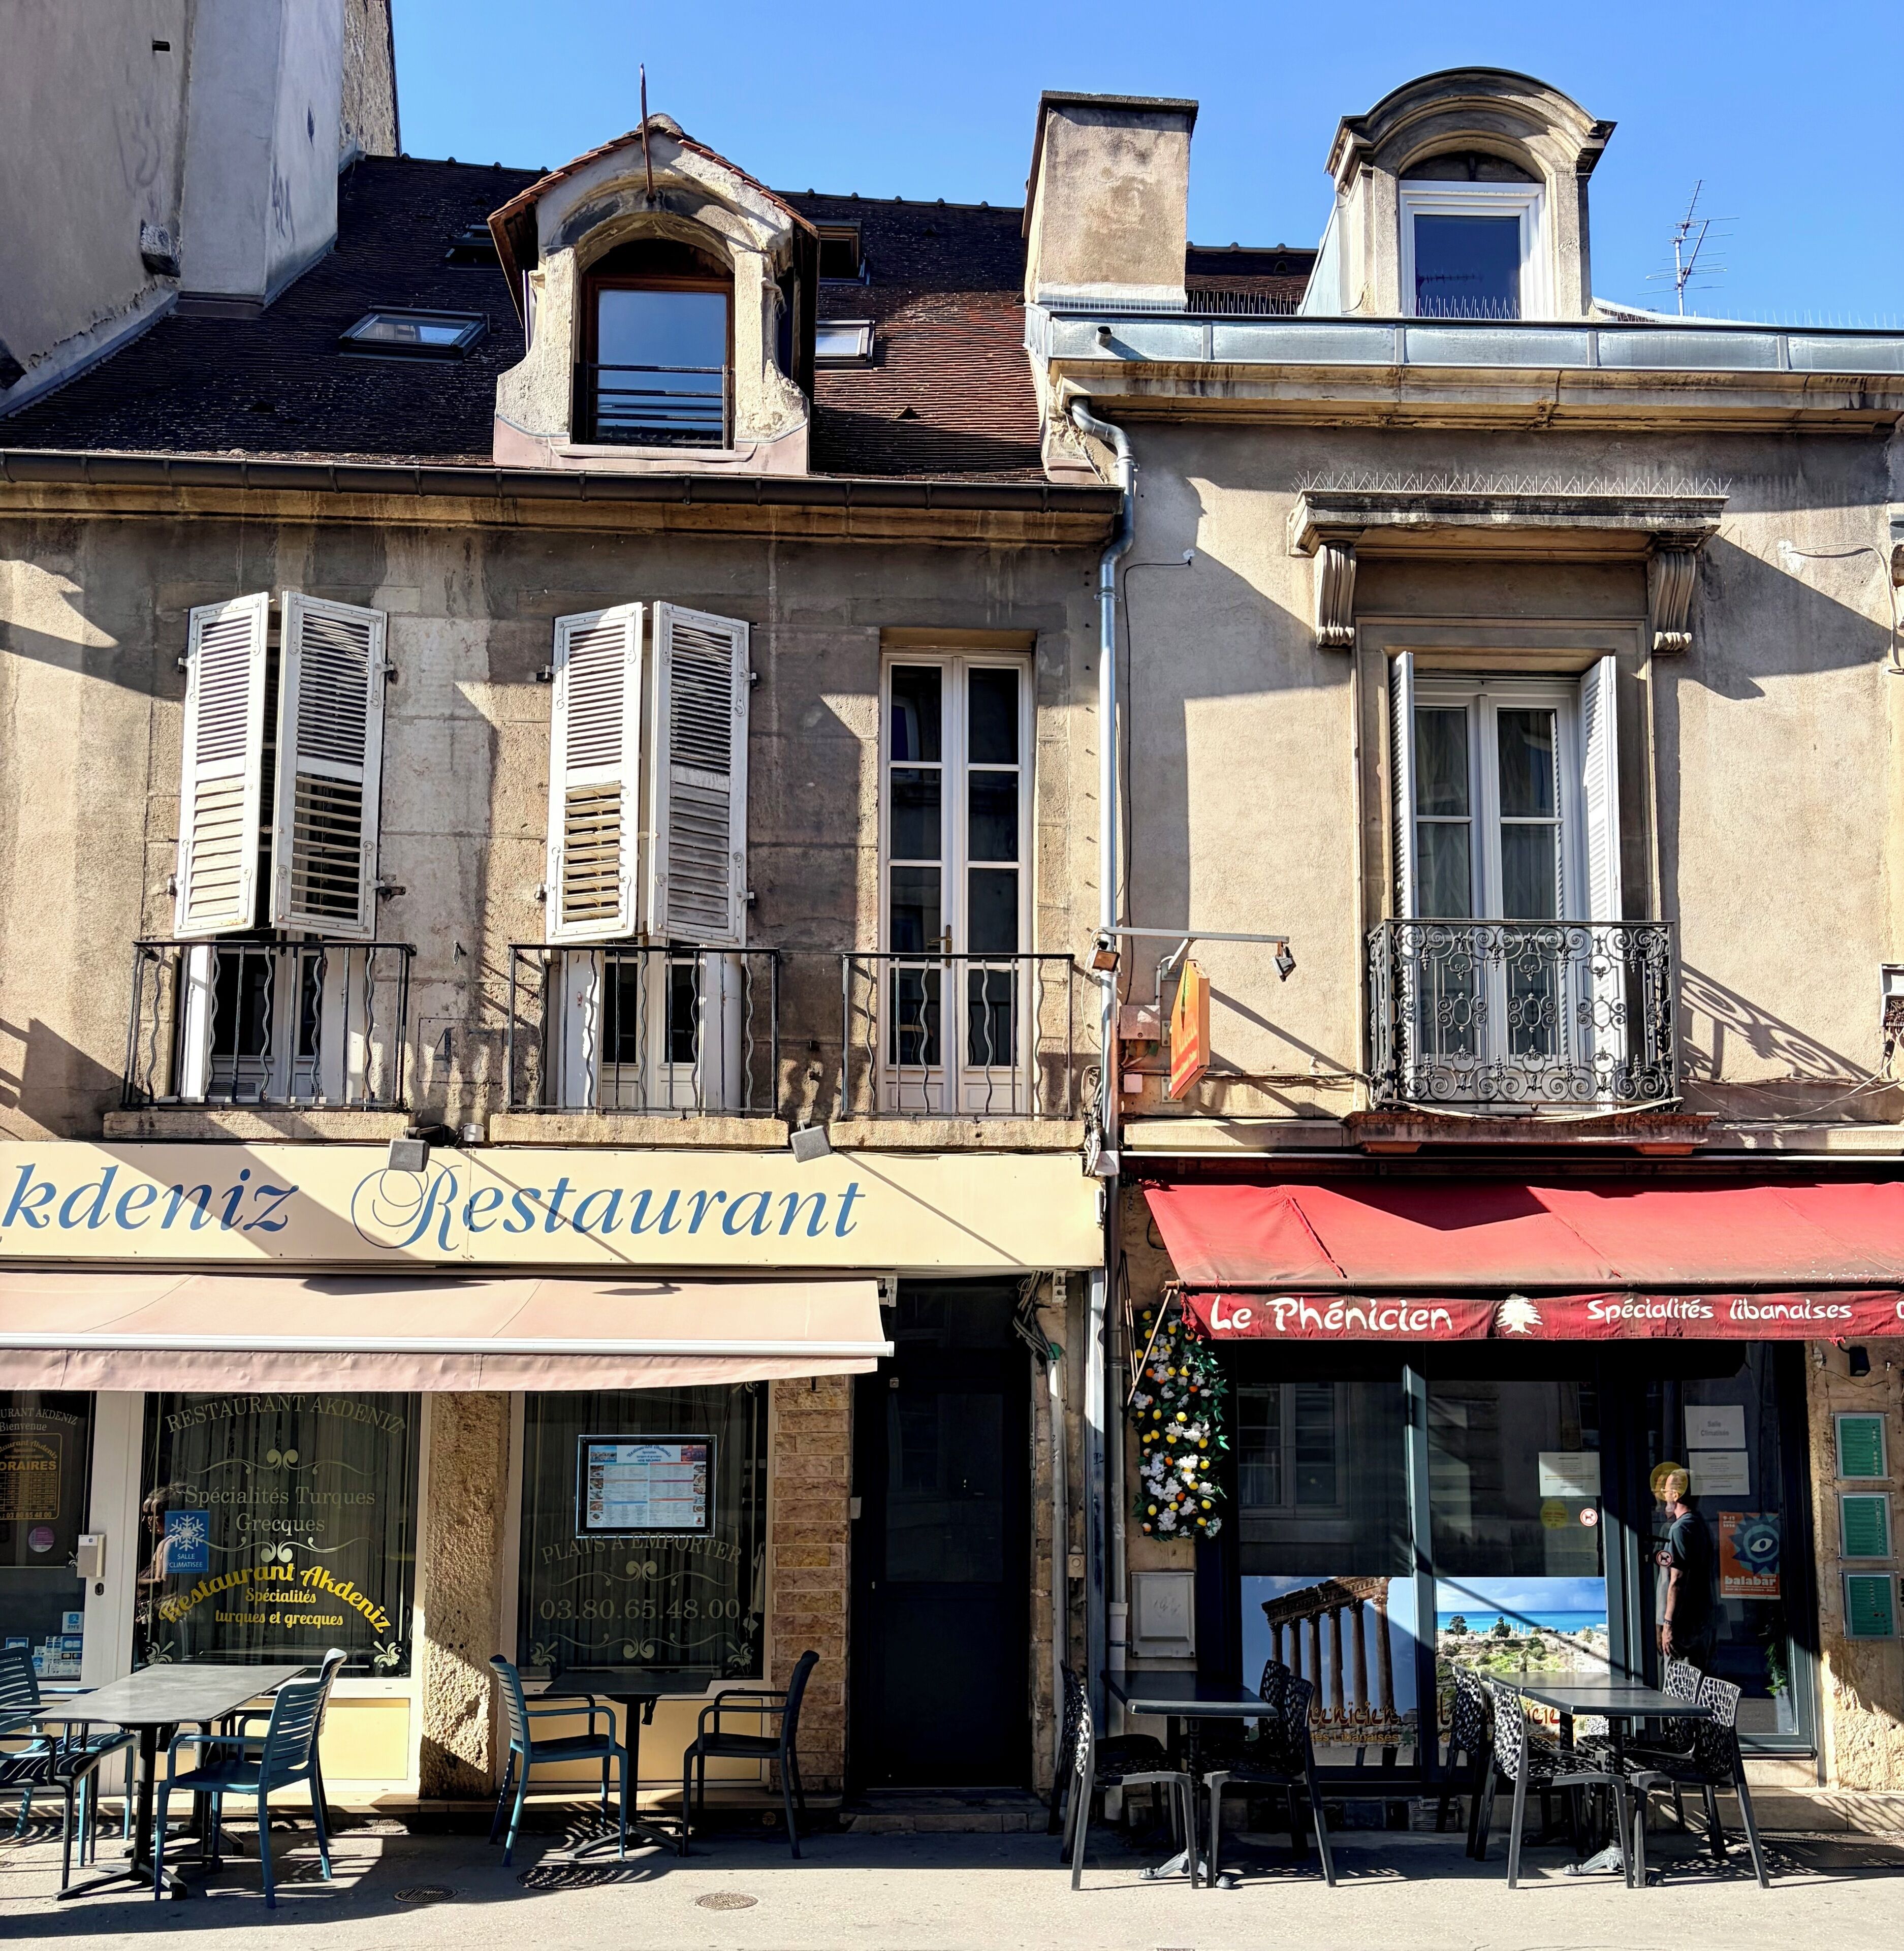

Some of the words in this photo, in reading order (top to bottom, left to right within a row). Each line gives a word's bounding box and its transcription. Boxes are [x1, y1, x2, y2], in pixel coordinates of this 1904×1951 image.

[0, 1163, 299, 1233] kdeniz
[351, 1158, 866, 1251] Restaurant
[1210, 1294, 1252, 1330] Le
[1265, 1297, 1453, 1332] Phénicien
[1587, 1297, 1715, 1324] Spécialités
[1729, 1297, 1853, 1320] libanaises
[0, 1407, 34, 1419] URANT
[36, 1409, 78, 1425] AKDENIZ
[165, 1395, 305, 1433] RESTAURANT
[310, 1398, 406, 1434] AKDENIZ
[185, 1486, 289, 1507] Spécialités
[295, 1487, 375, 1506] Turques
[236, 1513, 325, 1535] Grecques
[541, 1533, 606, 1564] PLATS
[630, 1531, 742, 1566] EMPORTER
[1725, 1576, 1776, 1586] balabar
[158, 1563, 295, 1624] Restaurant
[300, 1565, 392, 1633] Akdeniz
[245, 1587, 316, 1605] Spécialités
[215, 1609, 265, 1625] turques
[270, 1610, 281, 1624] et
[284, 1613, 343, 1629] grecques
[540, 1598, 740, 1620] 03.80.65.48.00
[1334, 1732, 1399, 1742] Libanaises
